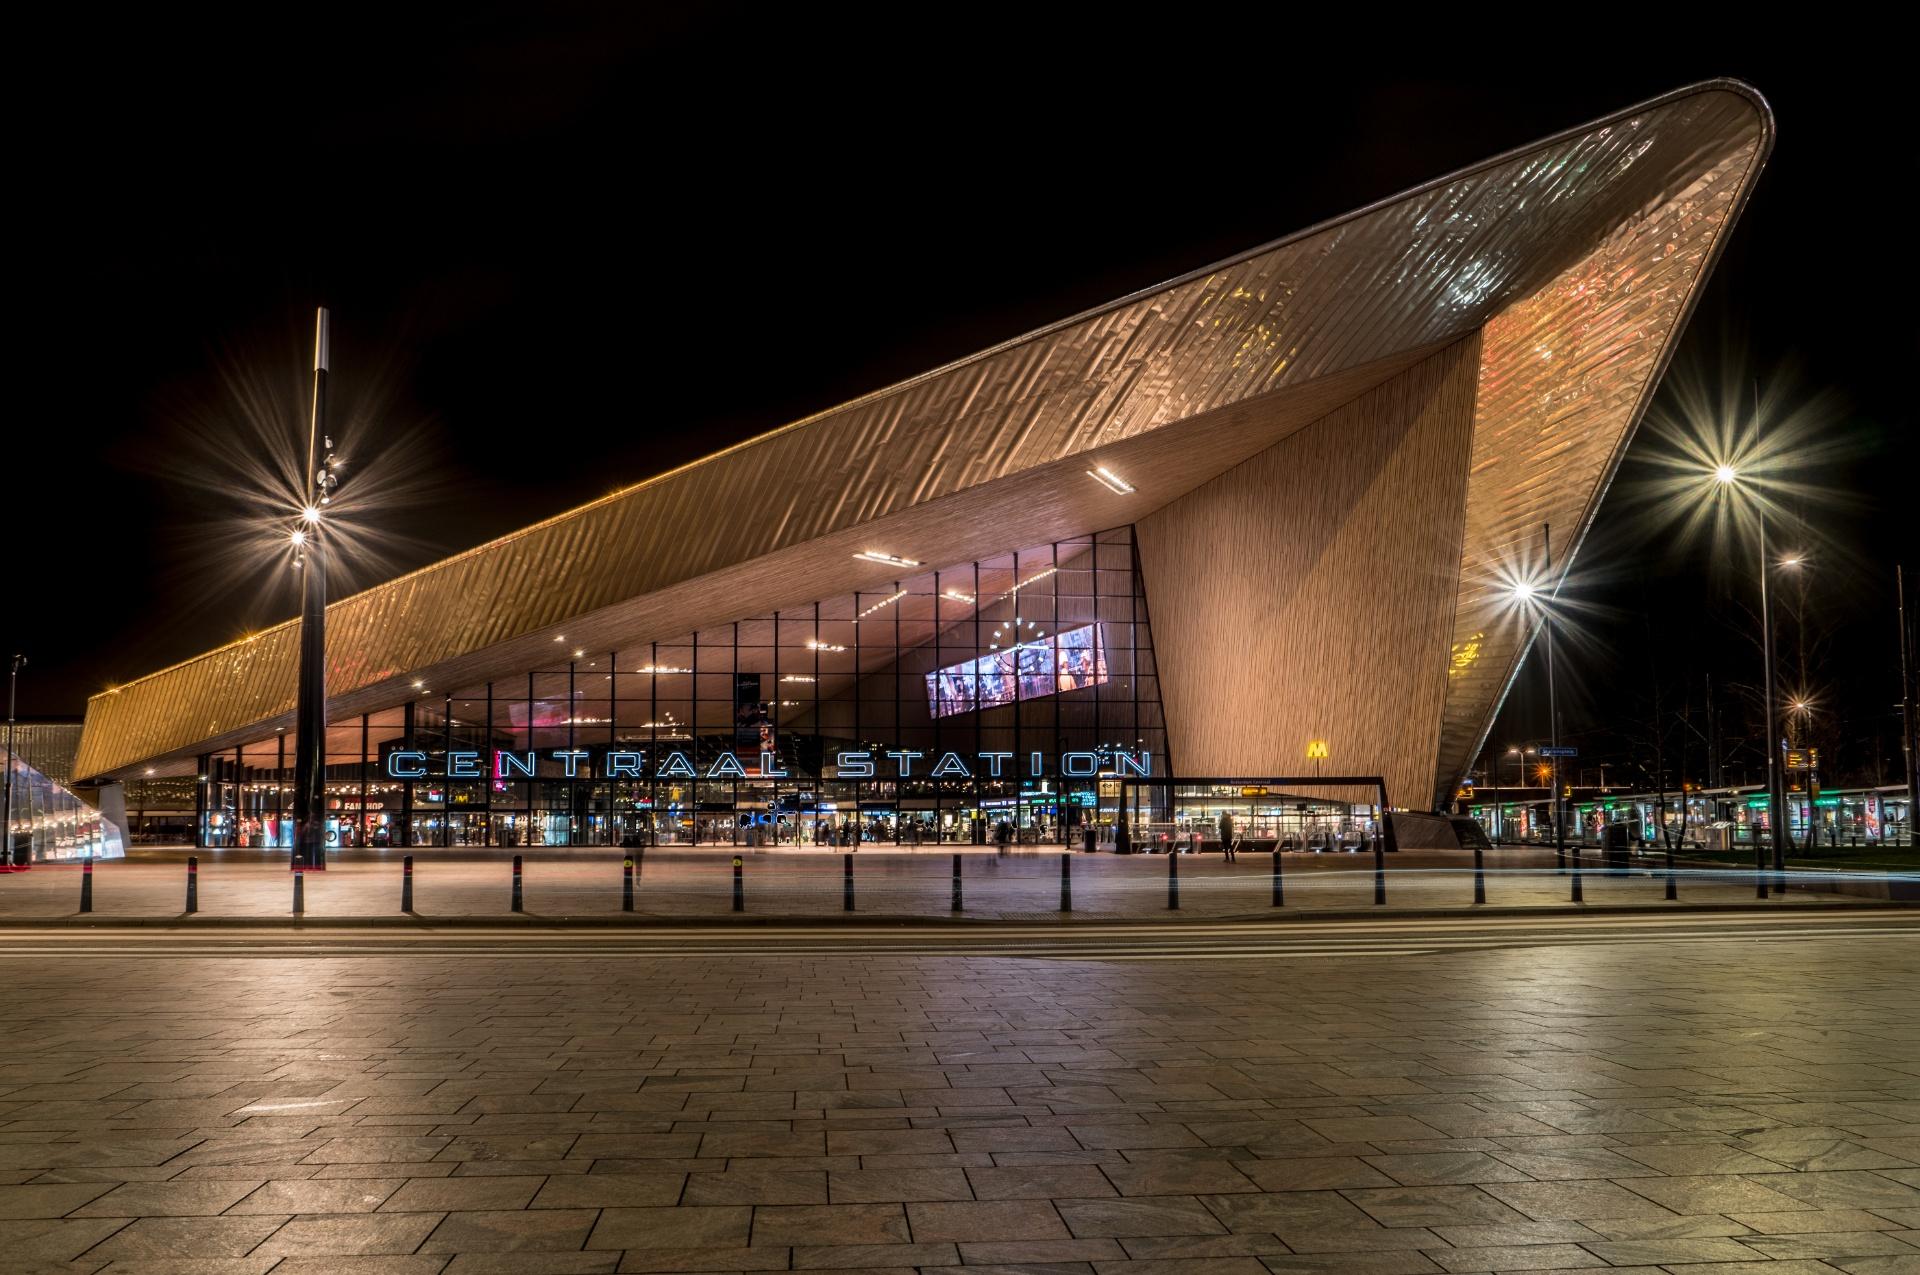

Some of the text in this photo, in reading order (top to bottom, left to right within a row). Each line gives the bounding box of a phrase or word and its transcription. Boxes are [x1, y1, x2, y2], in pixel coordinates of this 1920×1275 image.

[1308, 741, 1328, 757] M
[388, 752, 1150, 777] CENTRAAL STATION
[344, 802, 384, 810] FANHOP
